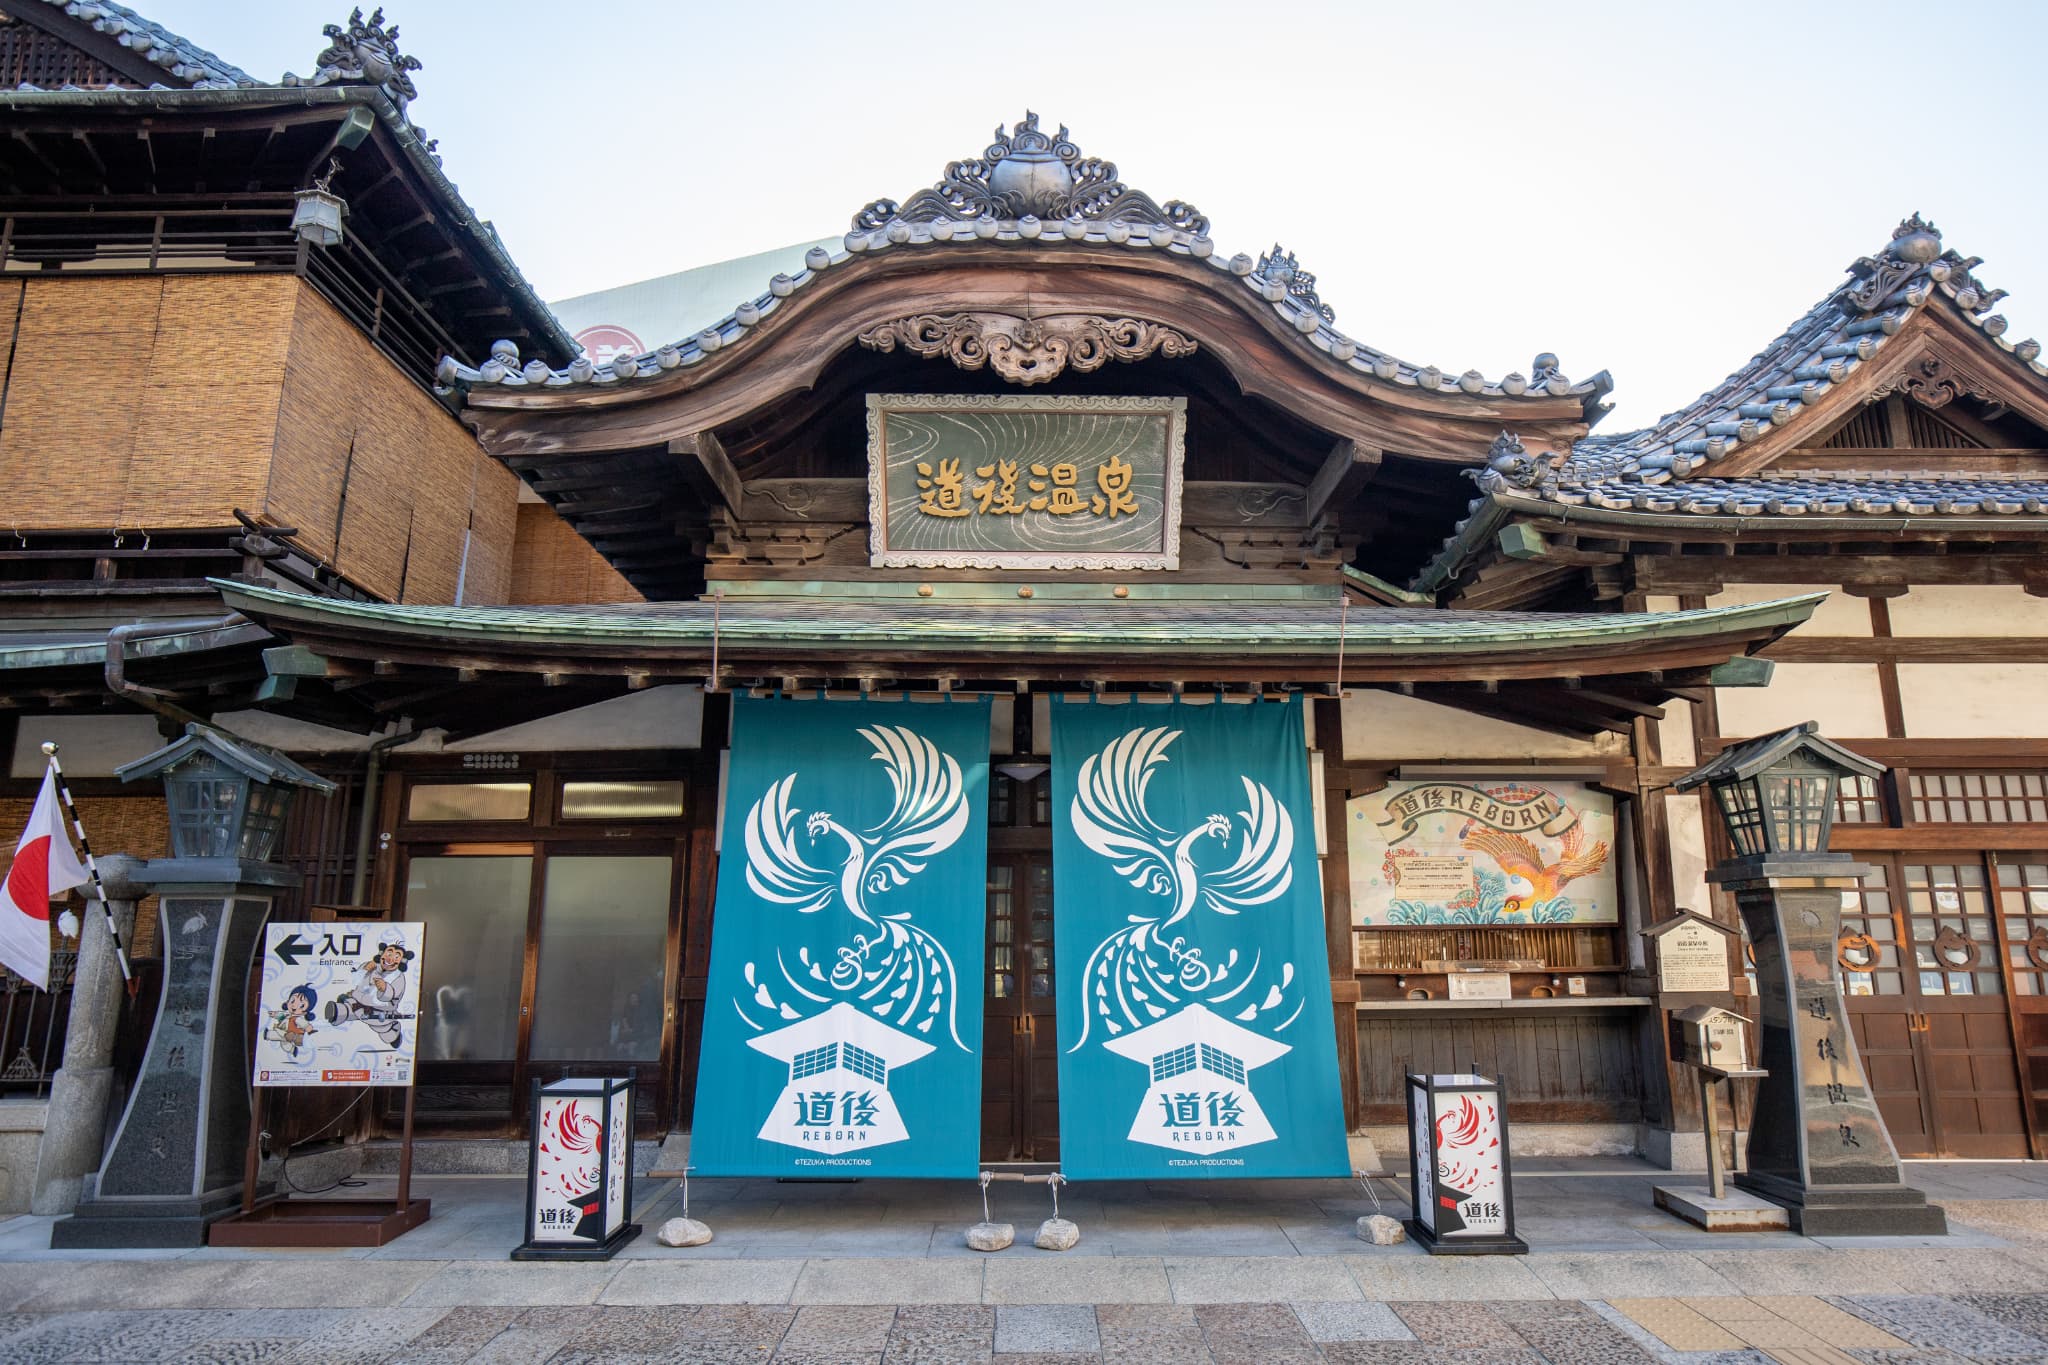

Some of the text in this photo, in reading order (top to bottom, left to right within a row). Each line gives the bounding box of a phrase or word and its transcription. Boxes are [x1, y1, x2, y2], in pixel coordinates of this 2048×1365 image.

[916, 455, 1140, 519] 道後温泉
[319, 934, 362, 956] 入口
[319, 958, 354, 966] Entrance
[793, 1089, 881, 1127] 道後
[1158, 1090, 1246, 1127] 道後
[802, 1130, 867, 1142] REBORN
[1172, 1130, 1236, 1142] REBORN
[826, 1158, 872, 1166] PRODUCTIONS
[1200, 1158, 1245, 1166] PRODUCTIONS
[539, 1208, 577, 1224] 道後
[1463, 1202, 1502, 1218] 道後
